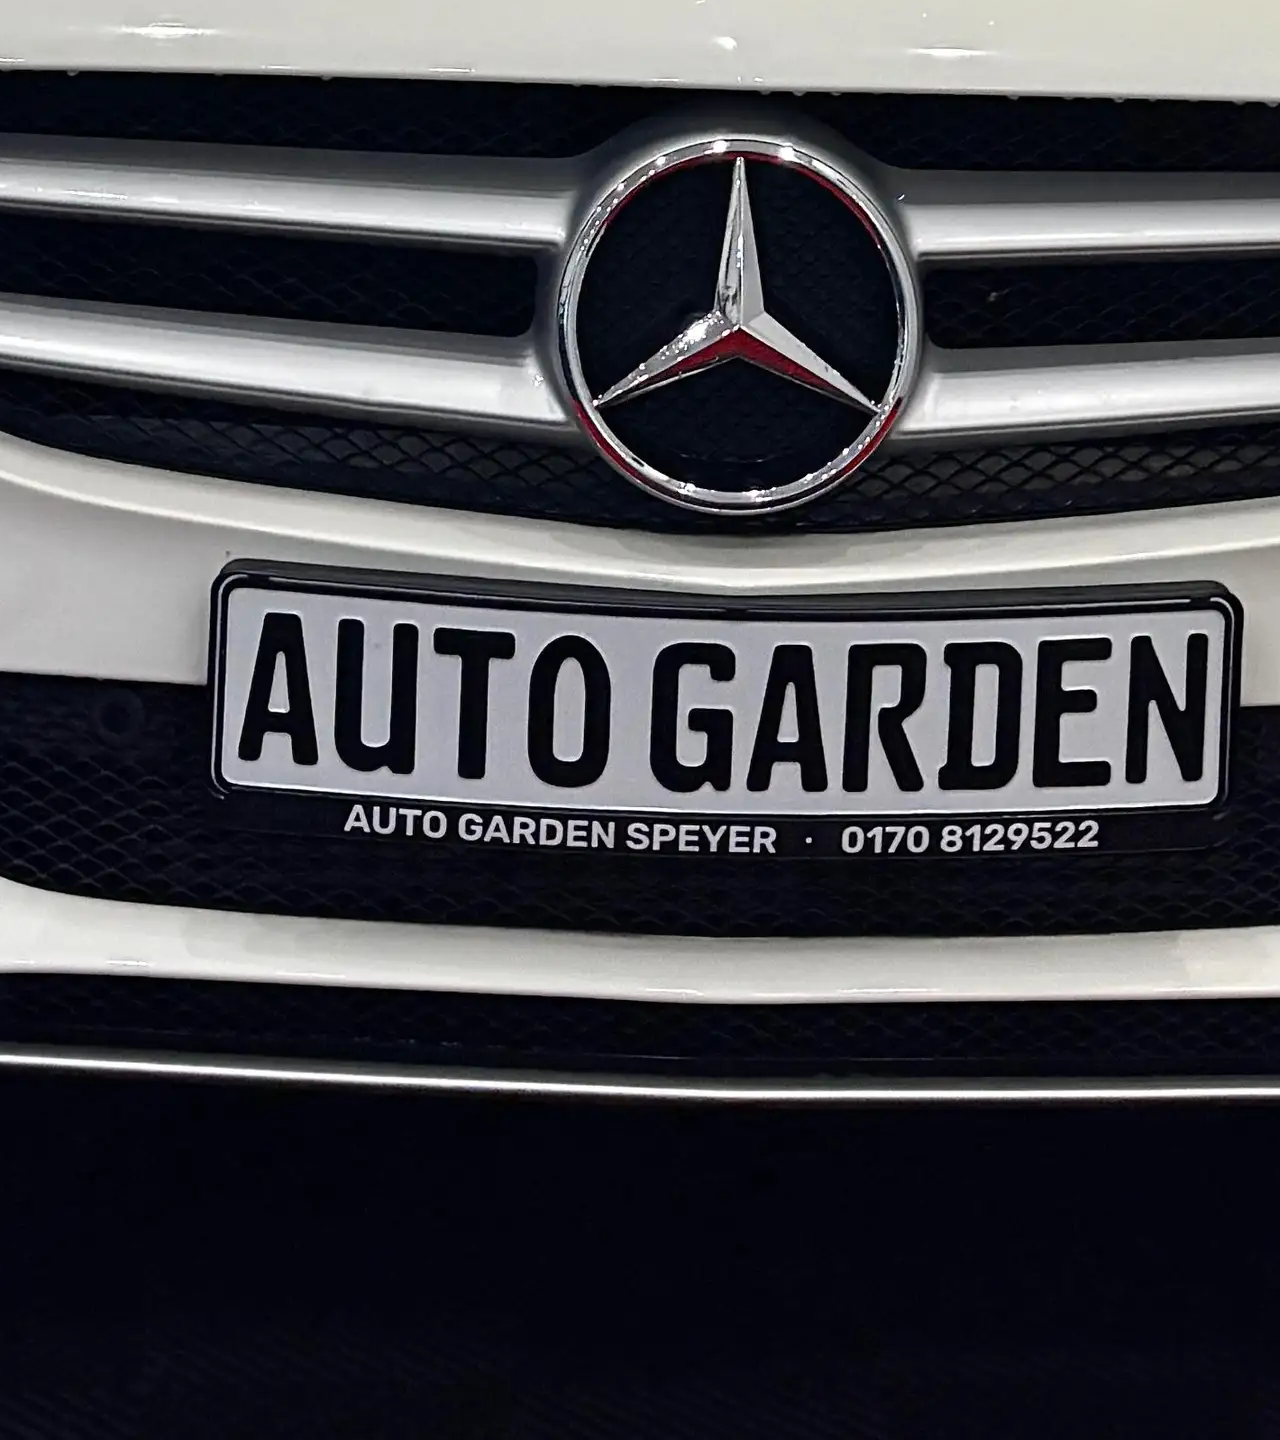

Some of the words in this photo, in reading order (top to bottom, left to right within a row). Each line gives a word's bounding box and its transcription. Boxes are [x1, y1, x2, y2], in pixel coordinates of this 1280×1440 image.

[238, 612, 611, 788] AUTO
[649, 632, 1209, 793] GARDEN
[343, 803, 448, 839] AUTO
[457, 813, 615, 849] GARDEN
[624, 822, 777, 854] SPEYER
[840, 825, 930, 854] 0170
[939, 819, 1100, 853] 8129522
